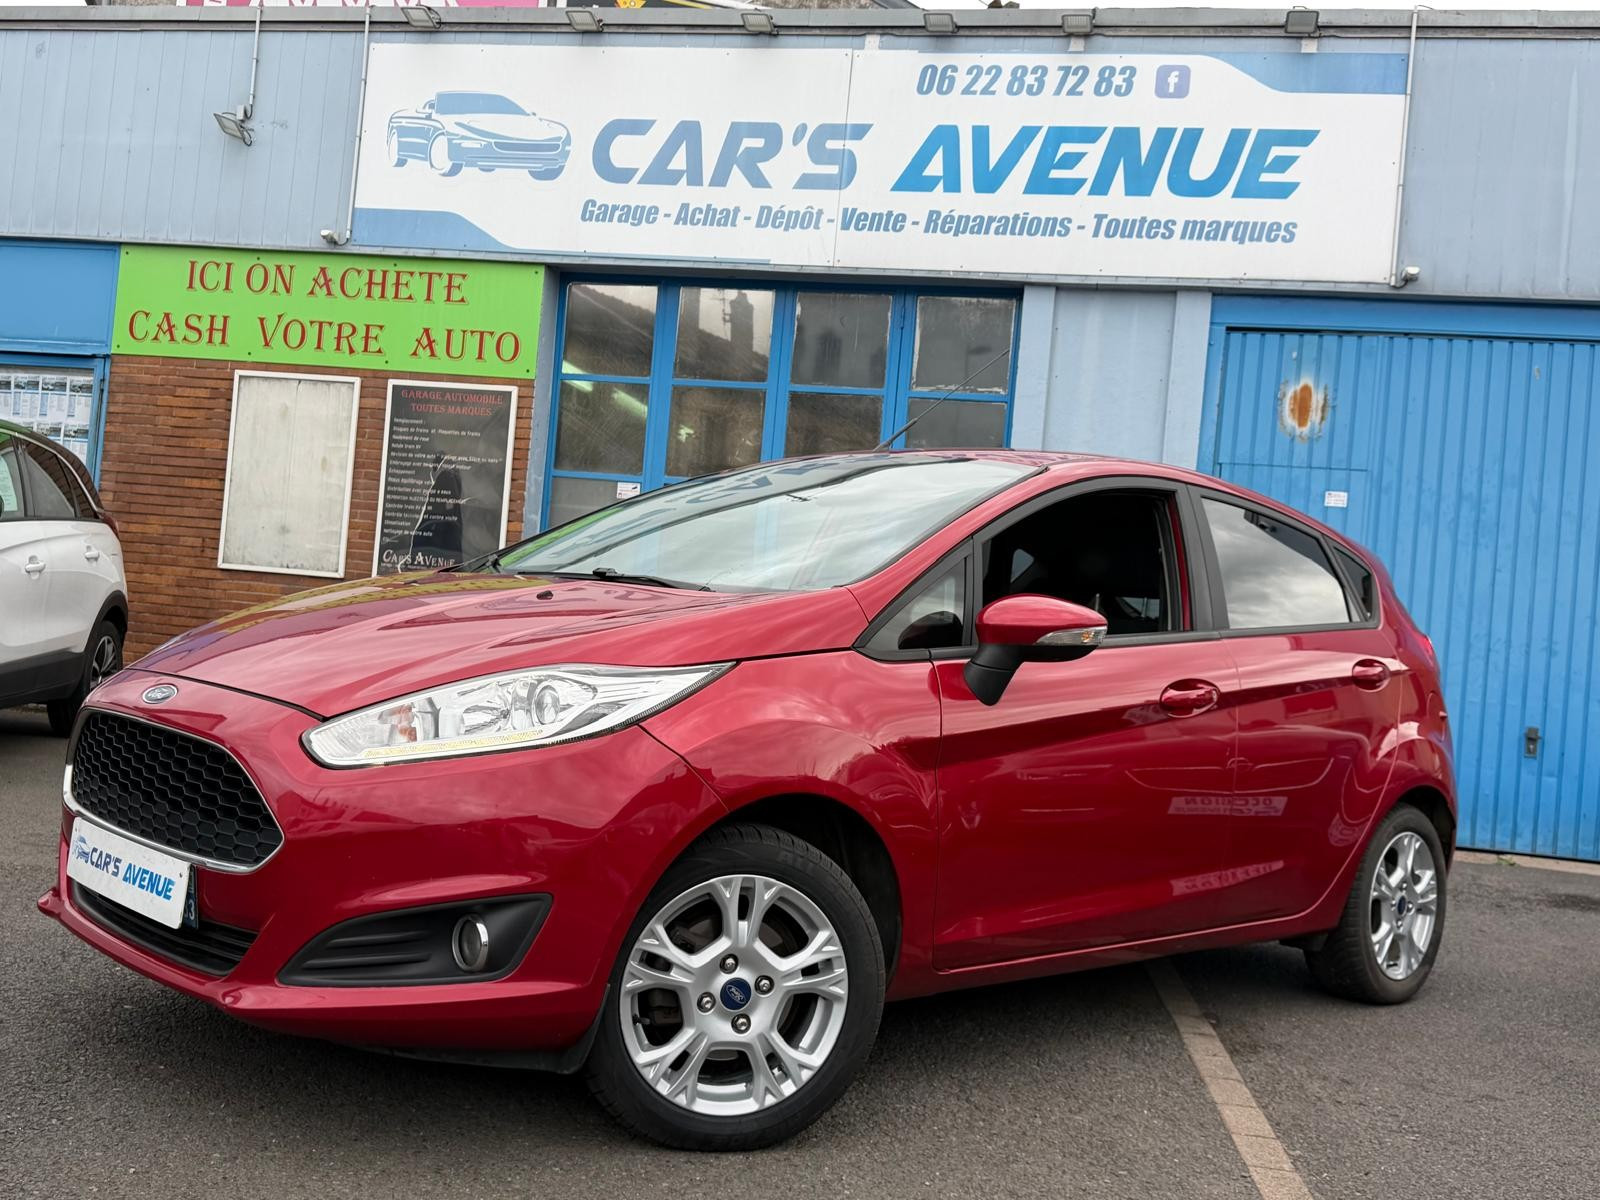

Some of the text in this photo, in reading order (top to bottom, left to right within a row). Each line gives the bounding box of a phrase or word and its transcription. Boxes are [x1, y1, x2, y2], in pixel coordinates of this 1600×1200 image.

[917, 64, 1136, 97] 06 22 83 72 83
[592, 118, 1321, 200] CAR'S AVENUE
[580, 199, 660, 226] Garage
[674, 203, 741, 227] Achat
[755, 205, 824, 232] Dépôt
[840, 207, 907, 232] Vente
[924, 209, 1072, 238] Réparations
[1092, 213, 1176, 240] Toutes
[1180, 219, 1298, 245] marques
[186, 260, 469, 304] ICI ON ACHETE
[128, 310, 520, 363] CASH VOTRE AUTO
[401, 389, 504, 405] GARAGE AUTOMOBILE
[411, 402, 493, 417] TOUTES MARQUES
[89, 846, 177, 901] CAR'S AVENUE
